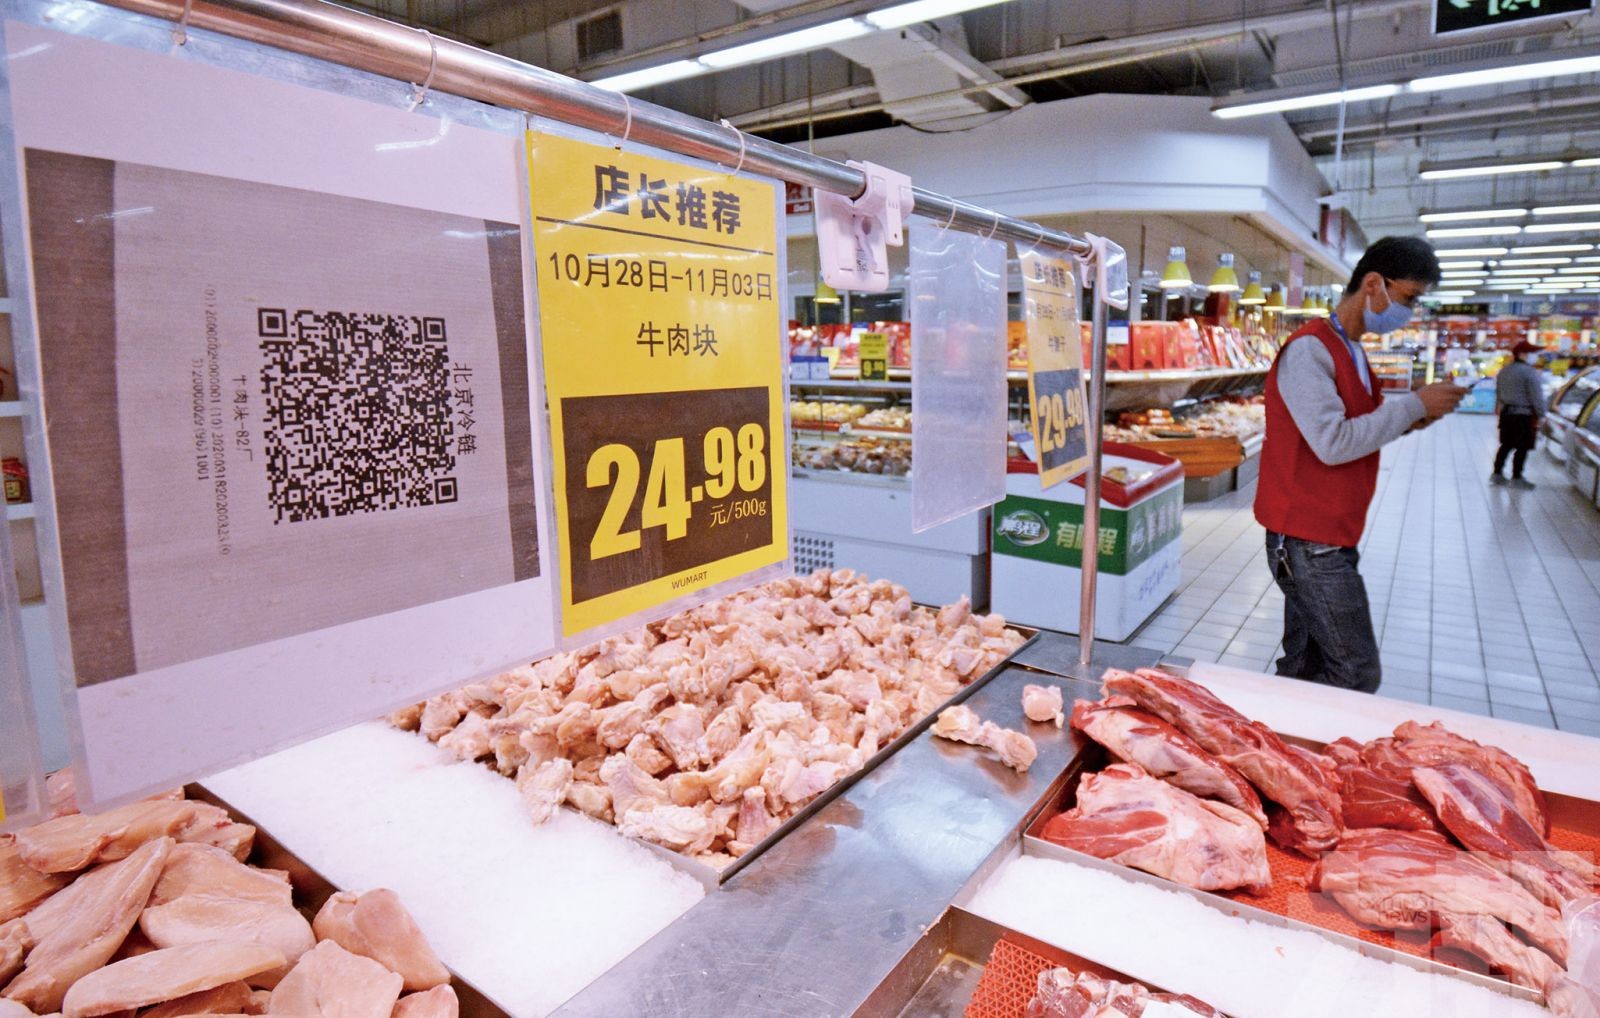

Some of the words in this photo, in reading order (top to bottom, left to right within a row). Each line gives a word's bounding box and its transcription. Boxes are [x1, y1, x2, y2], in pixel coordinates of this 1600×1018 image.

[593, 164, 742, 235] 店长推荐
[636, 320, 719, 358] 牛肉块
[453, 362, 477, 456] 北京冷链
[586, 422, 767, 561] 24.98
[709, 498, 767, 528] 元/500g
[1056, 521, 1119, 556] 有程
[671, 571, 708, 590] WUMART
